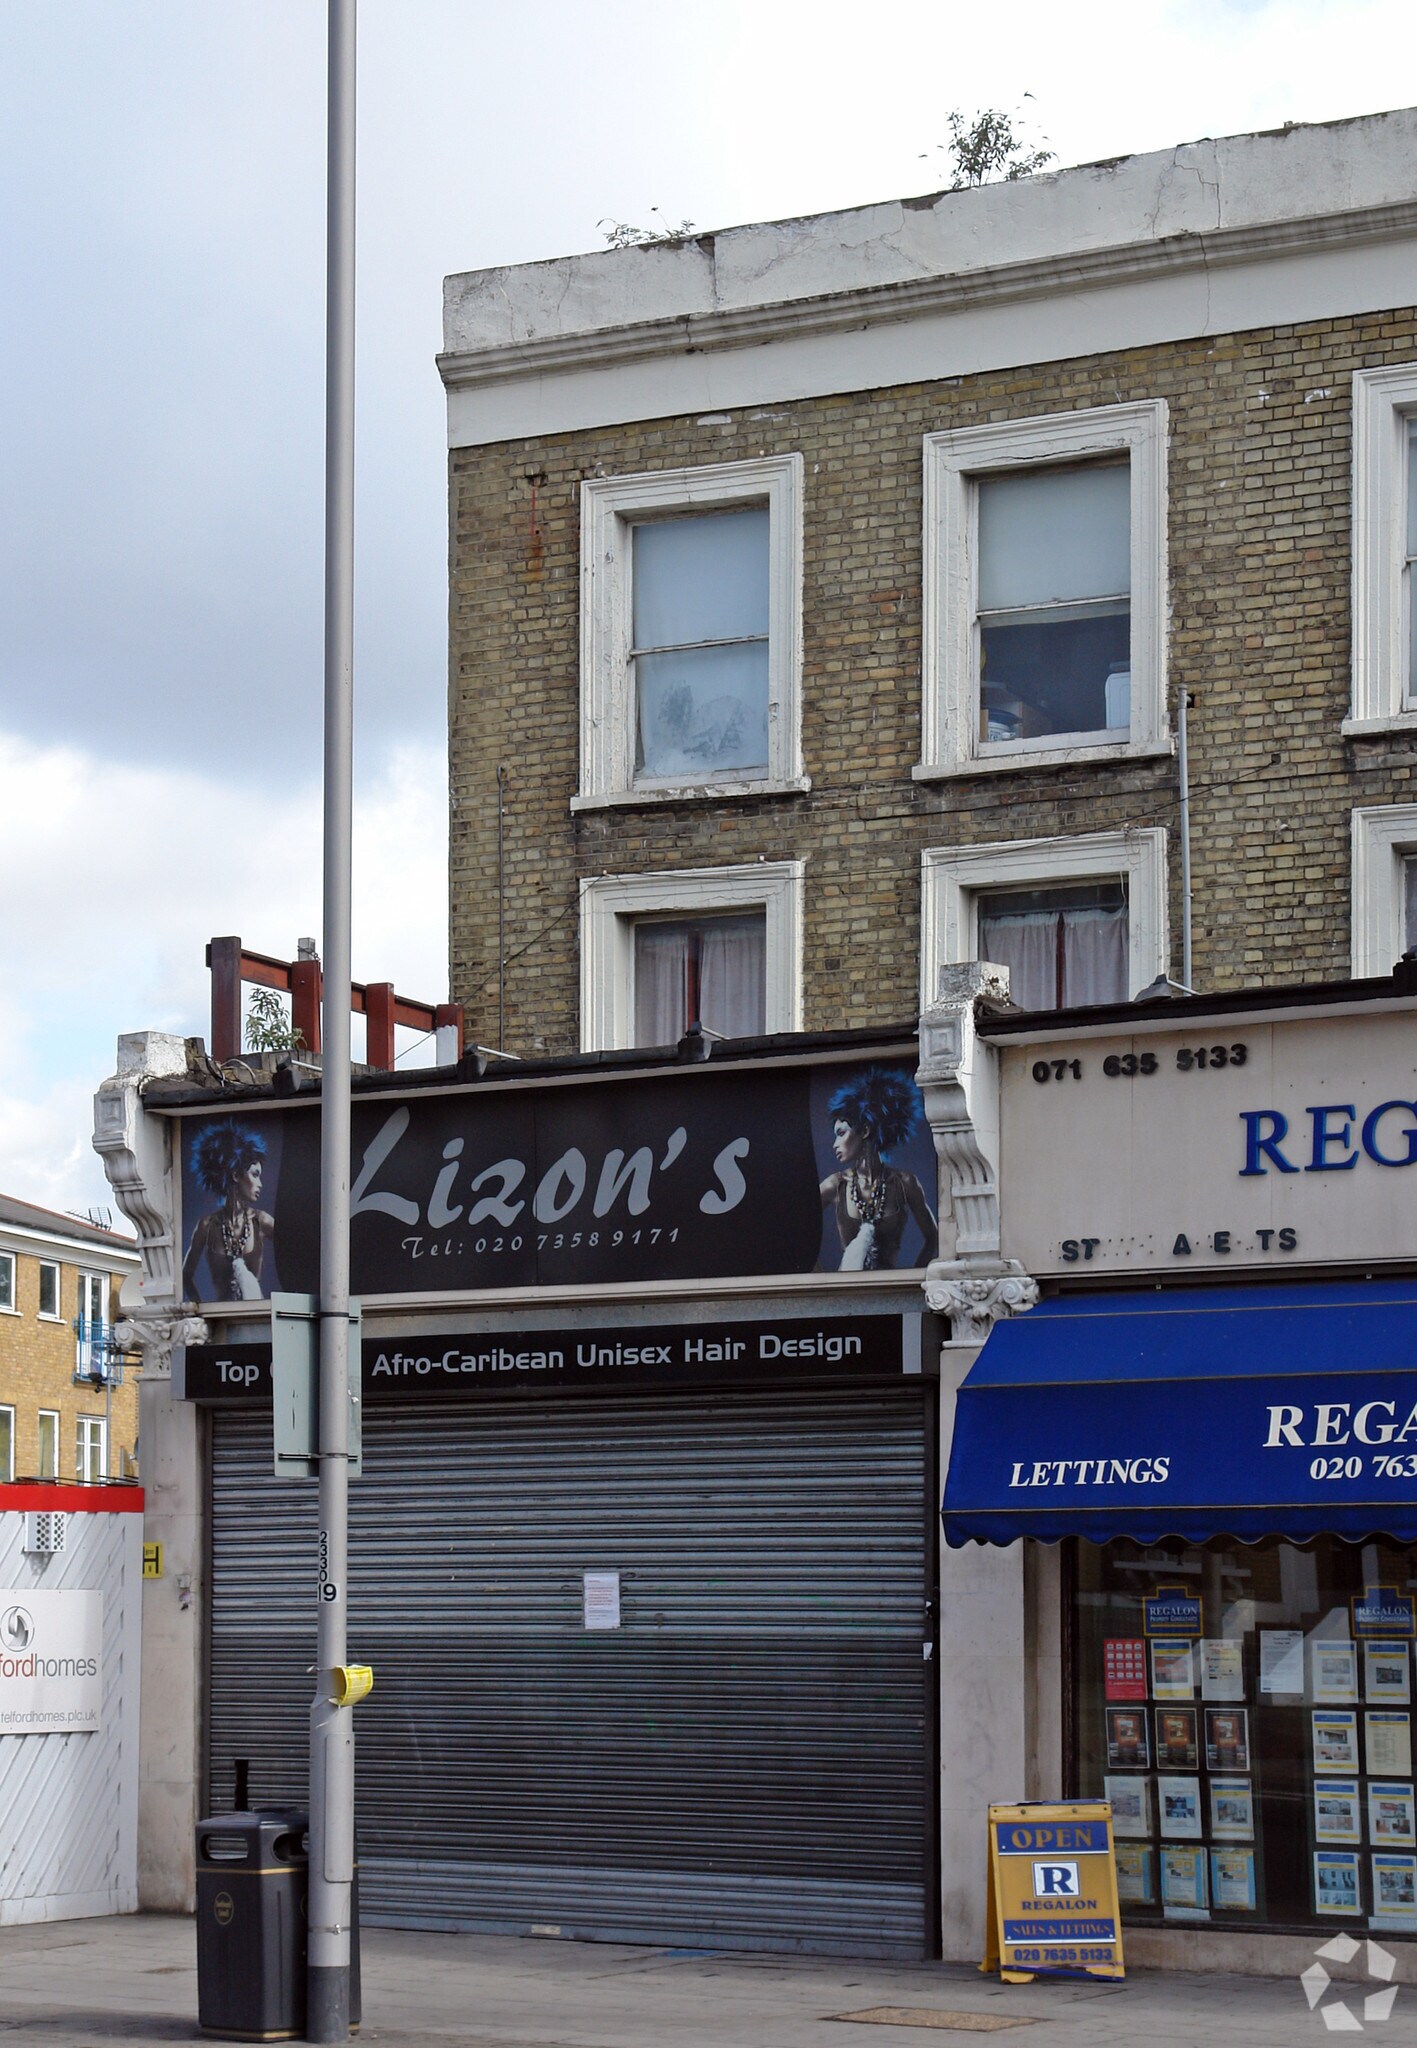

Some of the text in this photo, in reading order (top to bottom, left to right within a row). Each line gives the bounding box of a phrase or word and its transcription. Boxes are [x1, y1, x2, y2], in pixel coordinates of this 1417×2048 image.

[1032, 1043, 1248, 1083] 071 635 5133
[1239, 1100, 1417, 1176] REG
[350, 1106, 750, 1230] Lizon's
[402, 1228, 680, 1259] Tel: 020 7358 9171
[371, 1332, 862, 1377] Afro-Caribean Unisex Hair Design
[215, 1360, 260, 1386] Top
[1008, 1456, 1170, 1487] LETTINGS
[1309, 1454, 1417, 1480] 020 763
[318, 1583, 337, 1602] 19
[1150, 1606, 1197, 1616] REGALON
[1359, 1606, 1410, 1616] REGALON
[1011, 1828, 1092, 1848] OPEN
[1040, 1866, 1074, 1894] R
[1021, 1899, 1098, 1911] REGALON
[1012, 1924, 1046, 1936] SALES
[1060, 1924, 1111, 1935] LETTINGS
[1013, 1947, 1112, 1961] 020 7635 5133
